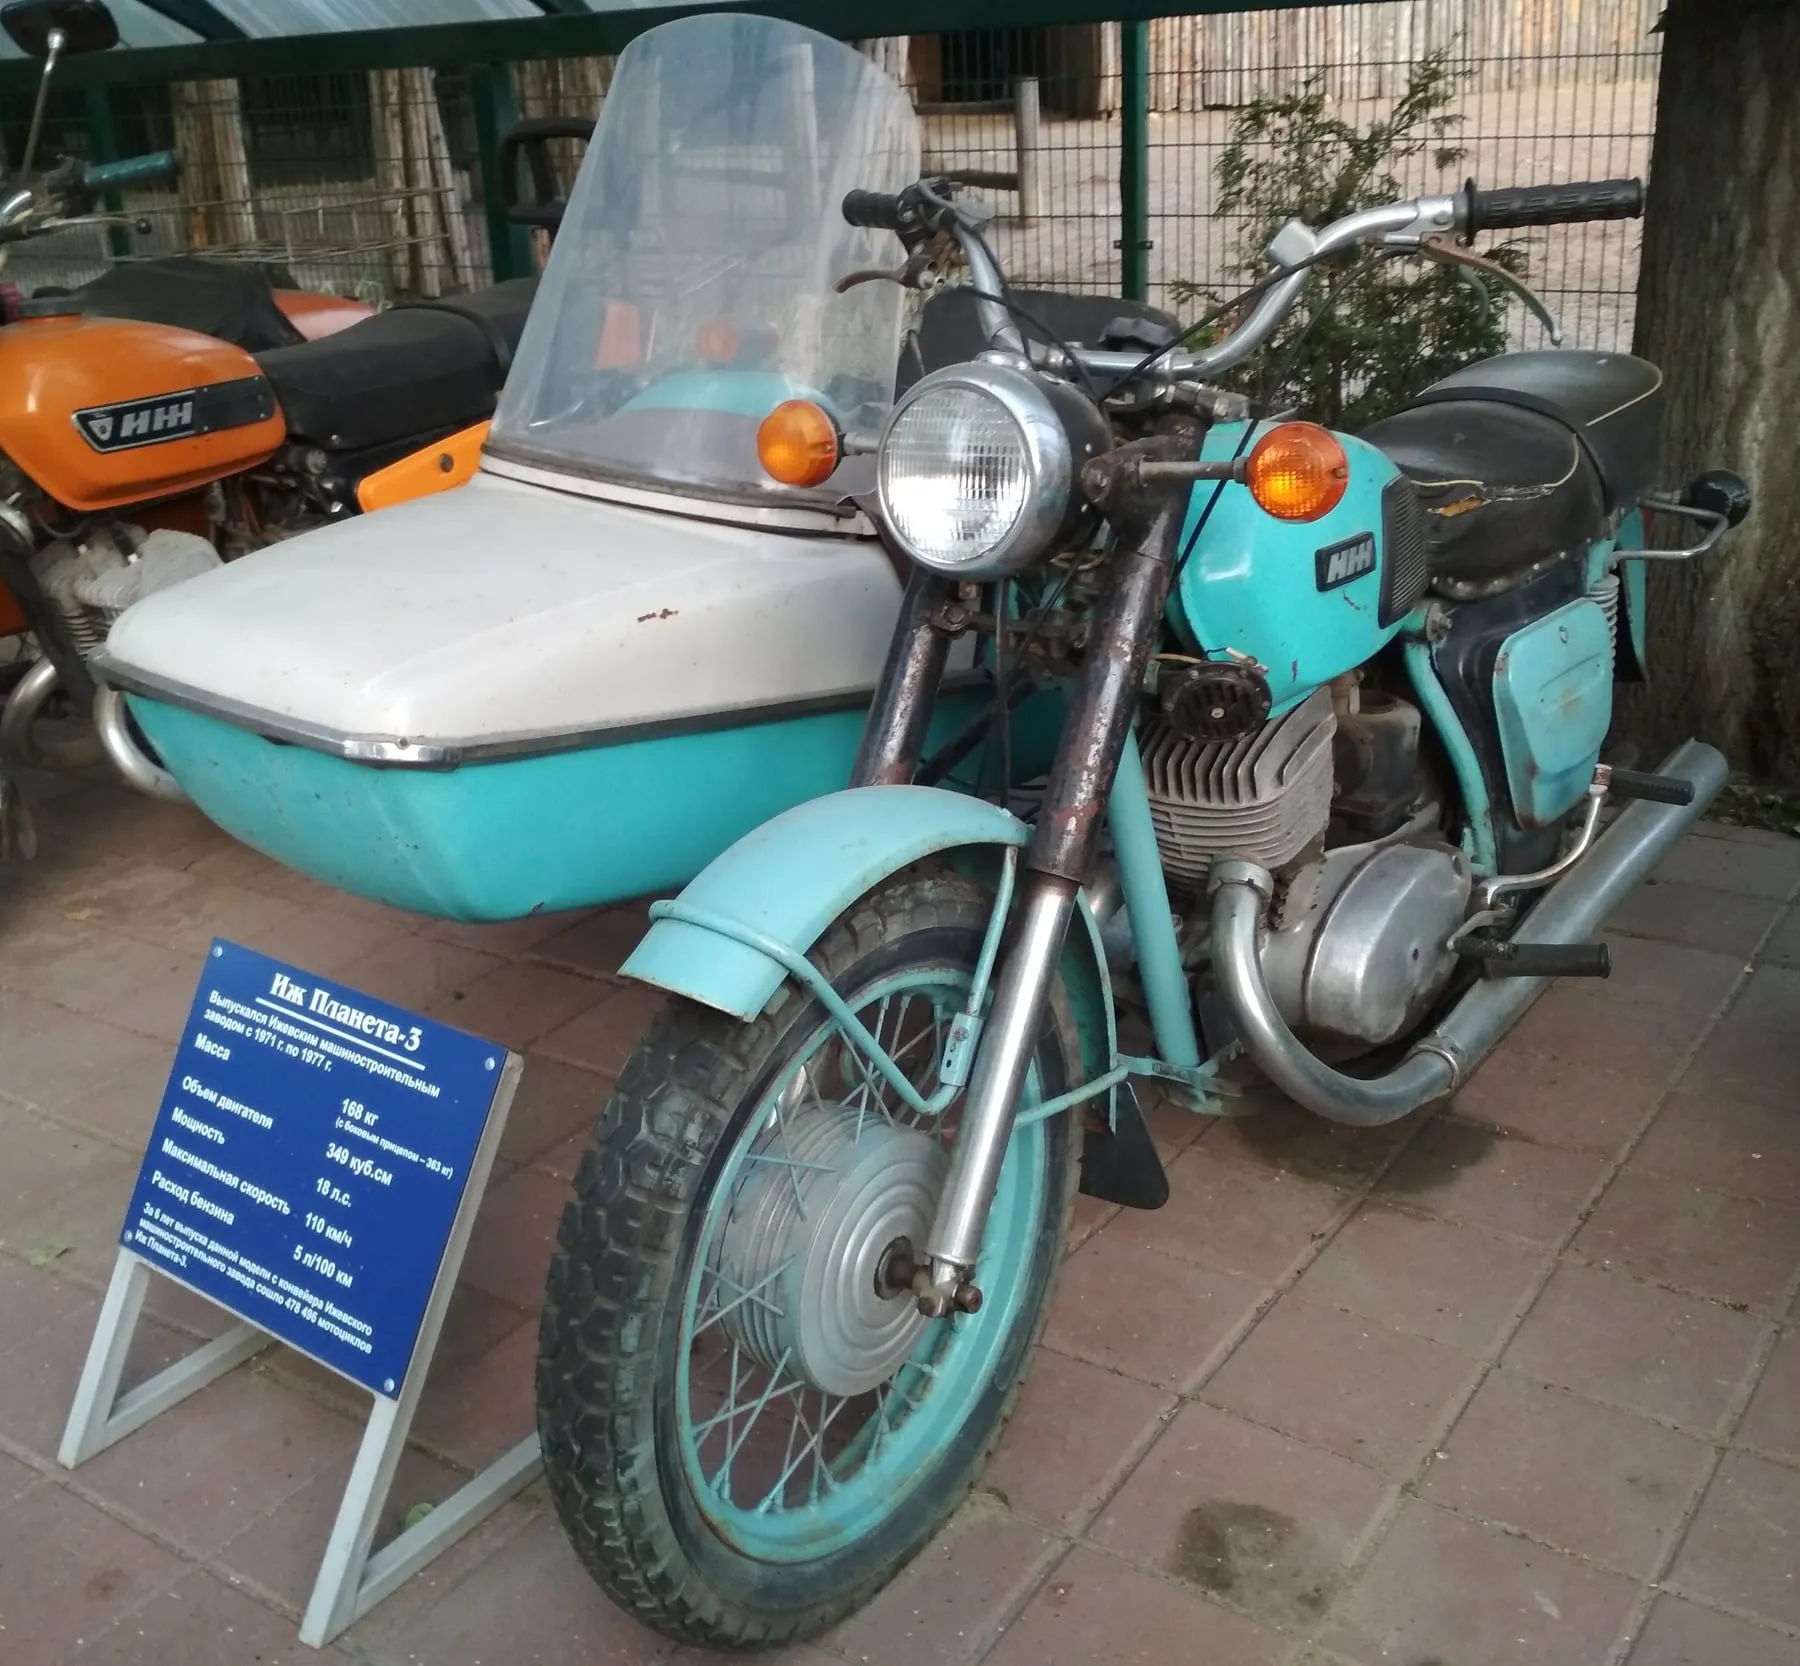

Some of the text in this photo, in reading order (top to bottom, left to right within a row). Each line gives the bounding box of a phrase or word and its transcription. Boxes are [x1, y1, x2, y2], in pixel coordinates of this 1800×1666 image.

[270, 973, 422, 1051] Иж Планета-3
[194, 1032, 230, 1061] Масса
[204, 1009, 332, 1072] заводом с 1971 г. по 1977 г.
[209, 990, 440, 1098] Выпускался Ижевским машиностроительным
[172, 1107, 225, 1145] Мощность
[182, 1076, 274, 1130] Объем двигателя
[342, 1098, 379, 1126] 168 кг
[326, 1142, 393, 1186] 349 куб.см
[335, 1116, 344, 1128] (с
[344, 1120, 379, 1144] боковым
[380, 1137, 419, 1162] прицепом
[426, 1158, 441, 1172] 363
[441, 1167, 454, 1180] кг)
[152, 1170, 235, 1226] Расход бензина
[162, 1138, 291, 1216] Максимальная скорость
[317, 1177, 330, 1196] 18
[135, 1230, 147, 1245] Иж
[305, 1212, 352, 1248] 110 км/ч
[139, 1218, 372, 1354] машиностроительного завода сошло 478 496 мотоциклов
[144, 1202, 372, 1336] За 6 лет выпуска данной модели с конвейера Ижевского
[293, 1245, 353, 1288] 5 л/100 км
